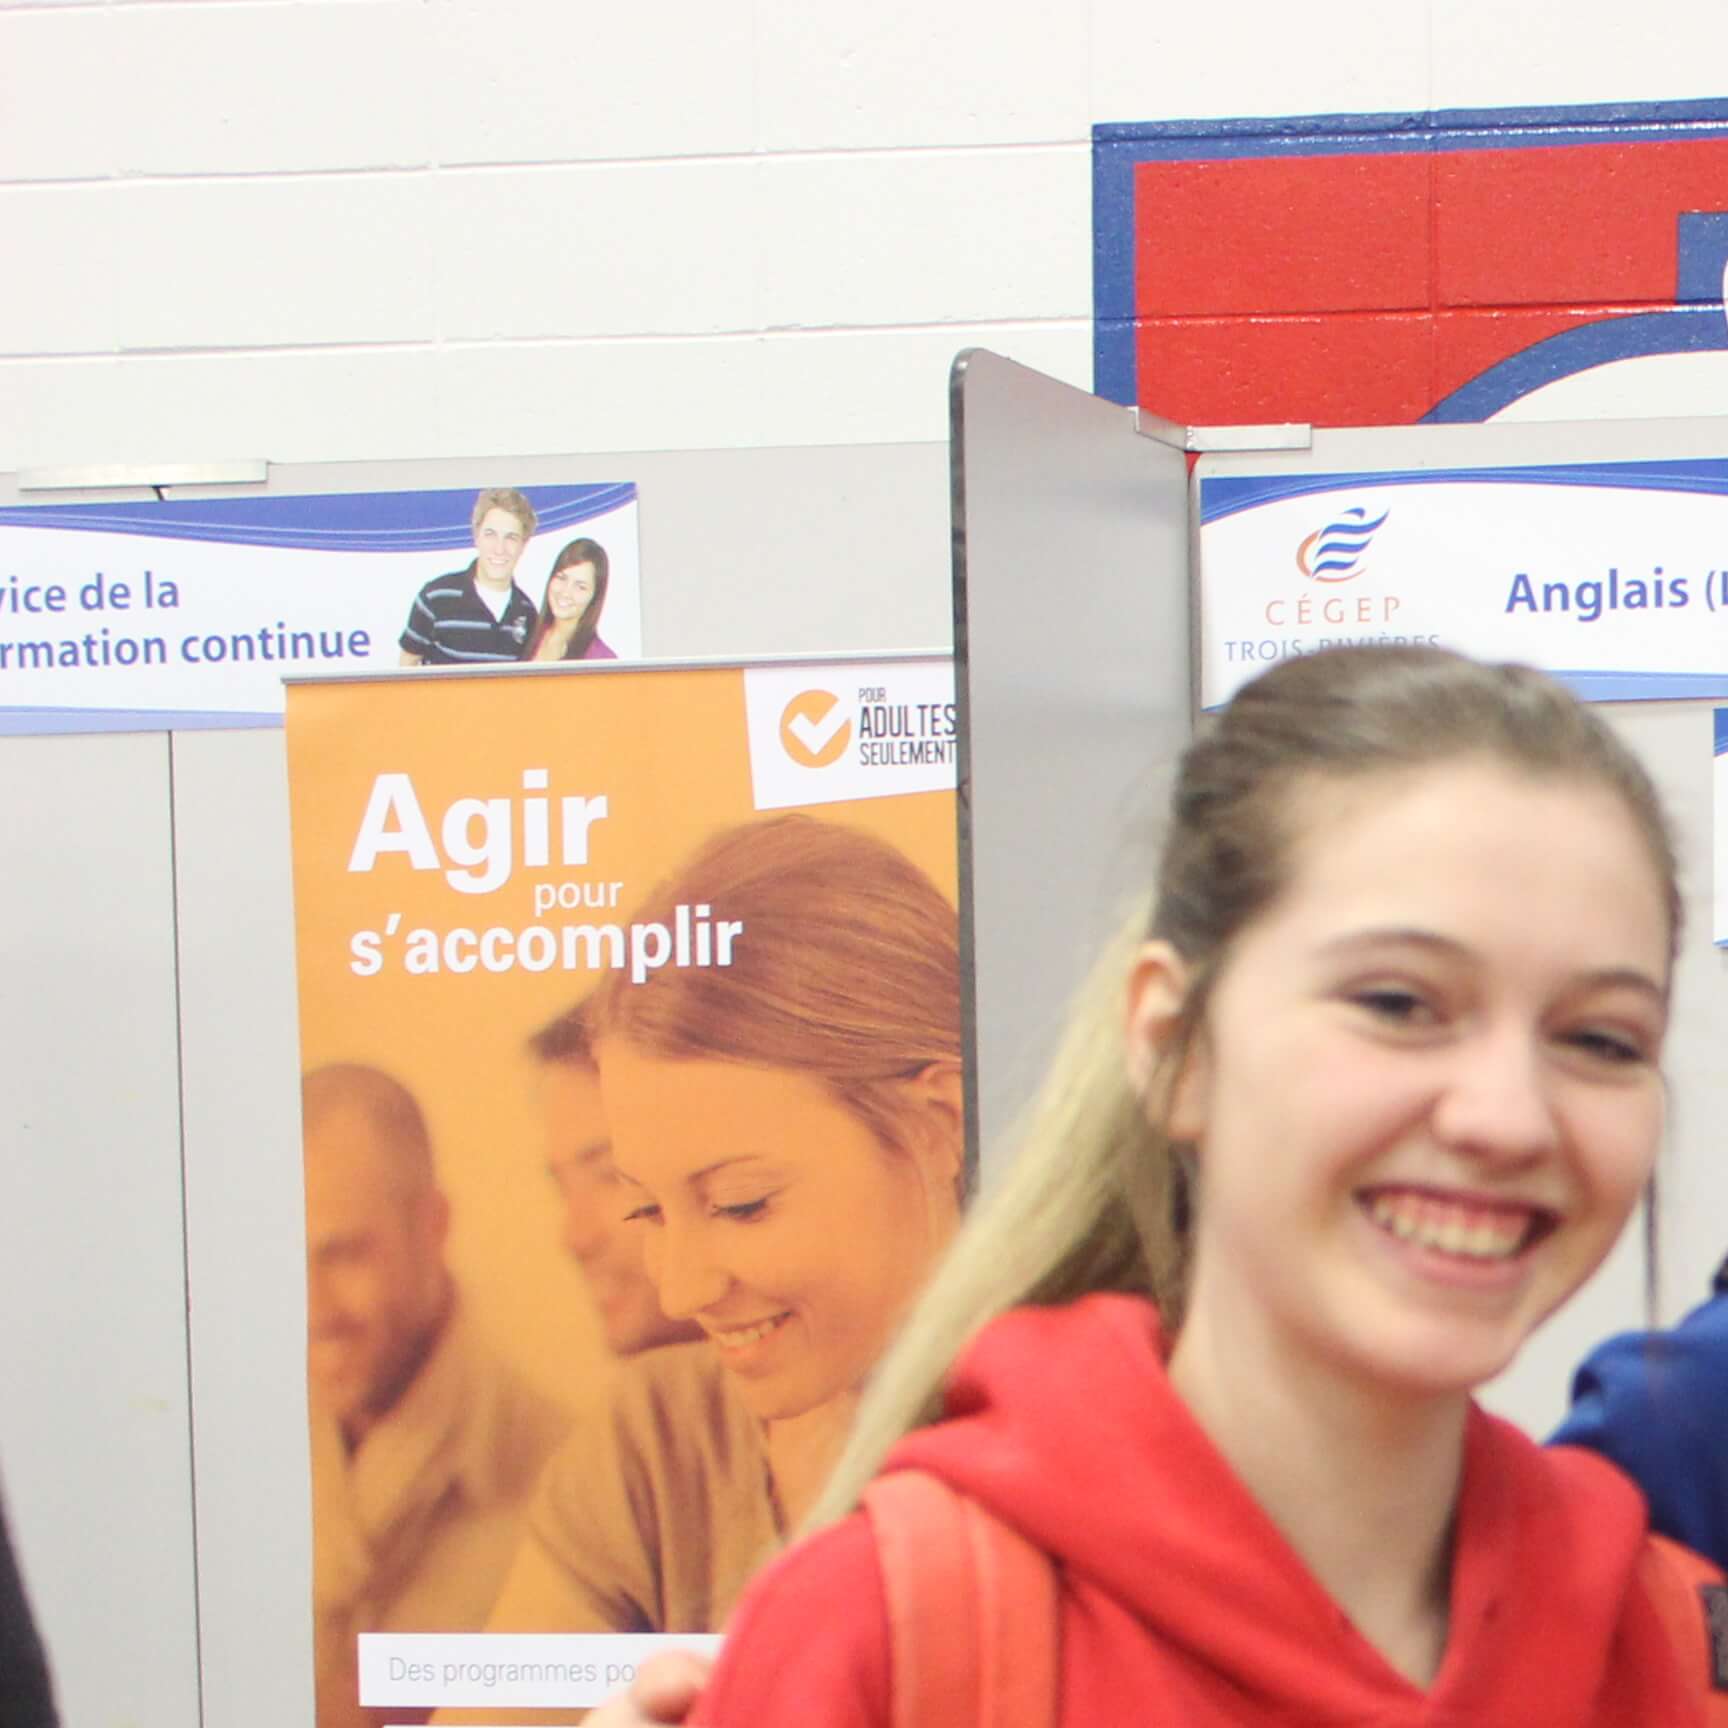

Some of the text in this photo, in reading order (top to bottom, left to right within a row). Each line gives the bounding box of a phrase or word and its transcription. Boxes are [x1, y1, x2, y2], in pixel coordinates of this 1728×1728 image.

[0, 570, 180, 612] ice de la
[1264, 593, 1401, 626] CÉGEP
[1505, 567, 1690, 622] Anglais
[181, 621, 371, 663] continue
[858, 687, 888, 704] POUR
[859, 703, 960, 739] ADULTES
[859, 740, 960, 767] SEULEMENT
[346, 769, 608, 894] Agir
[533, 877, 623, 918] pour
[348, 904, 743, 984] s'accomplir
[388, 1656, 636, 1689] Des programmes po
